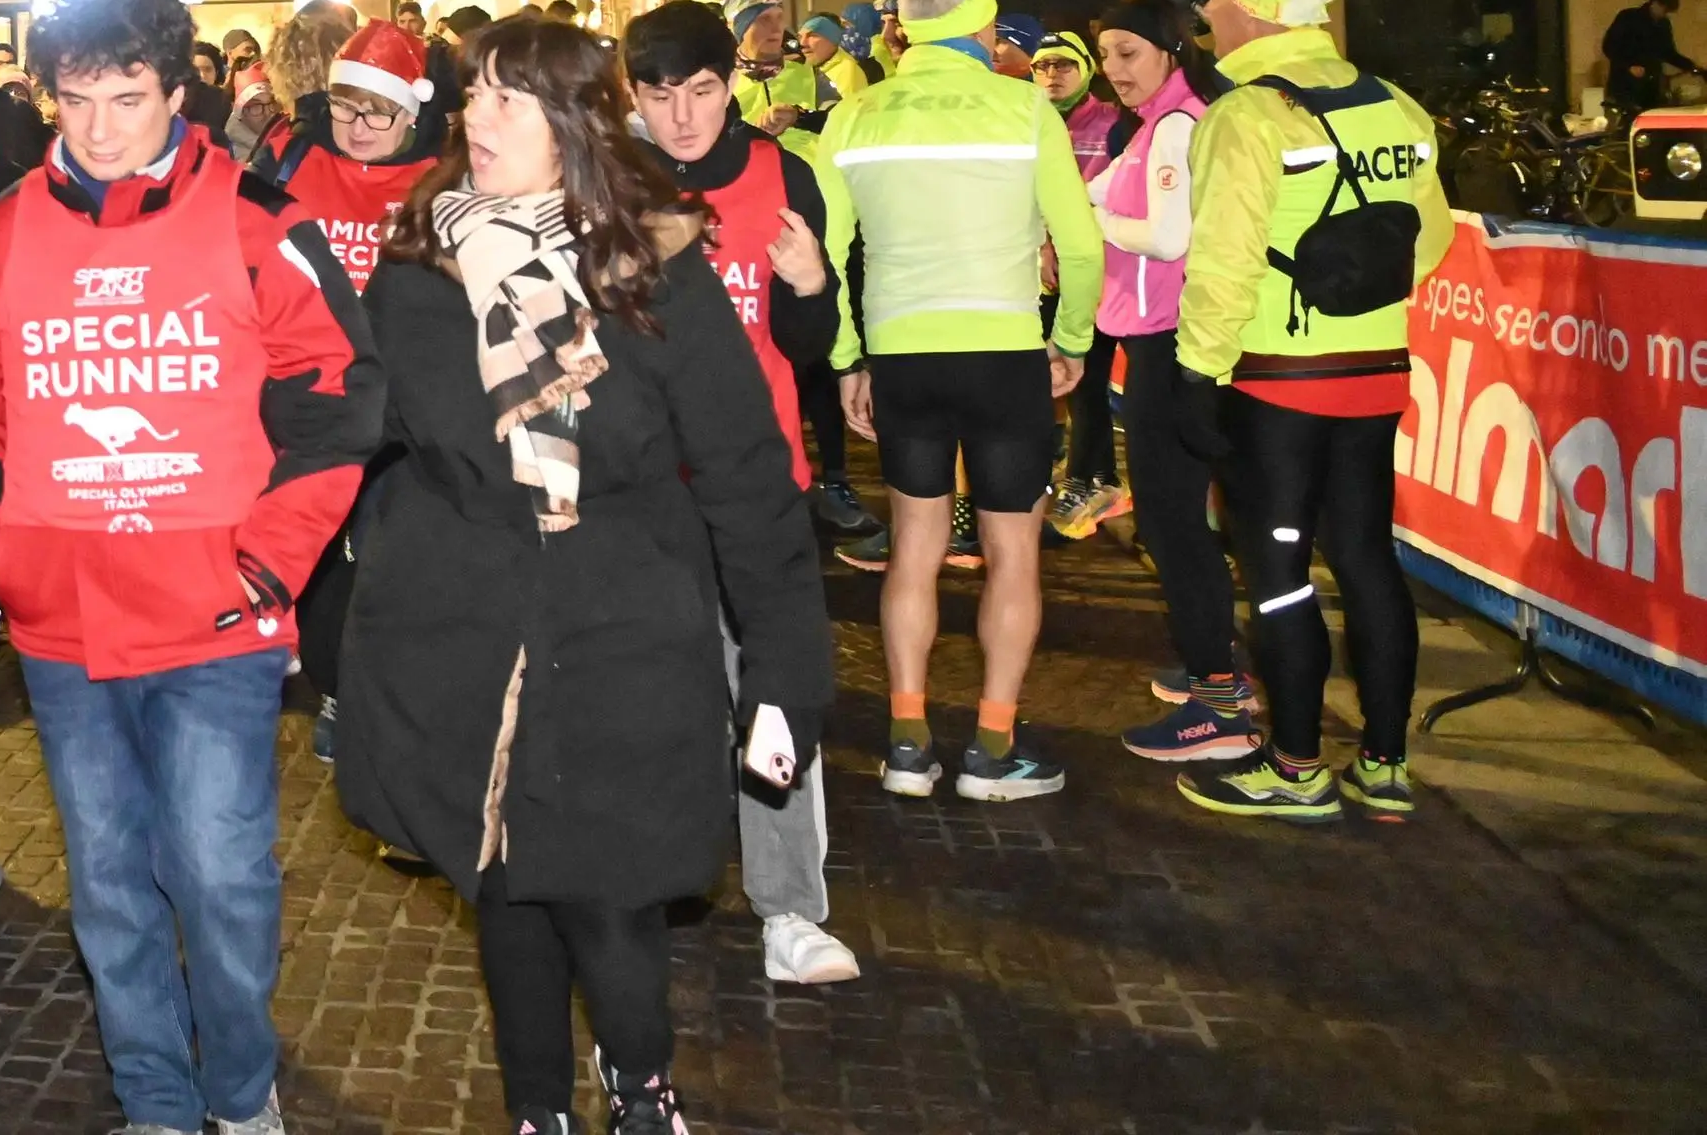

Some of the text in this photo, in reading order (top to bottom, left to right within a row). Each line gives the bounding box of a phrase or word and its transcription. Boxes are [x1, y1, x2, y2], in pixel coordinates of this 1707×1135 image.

[1353, 144, 1417, 183] ACER
[73, 266, 151, 285] SPORT
[84, 279, 144, 298] LAND
[1423, 275, 1493, 333] spes
[21, 310, 221, 356] SPECIAL
[25, 354, 221, 399] RUNNER
[68, 481, 188, 500] SPECIAL OLYMPICS
[103, 497, 150, 511] ITALIA
